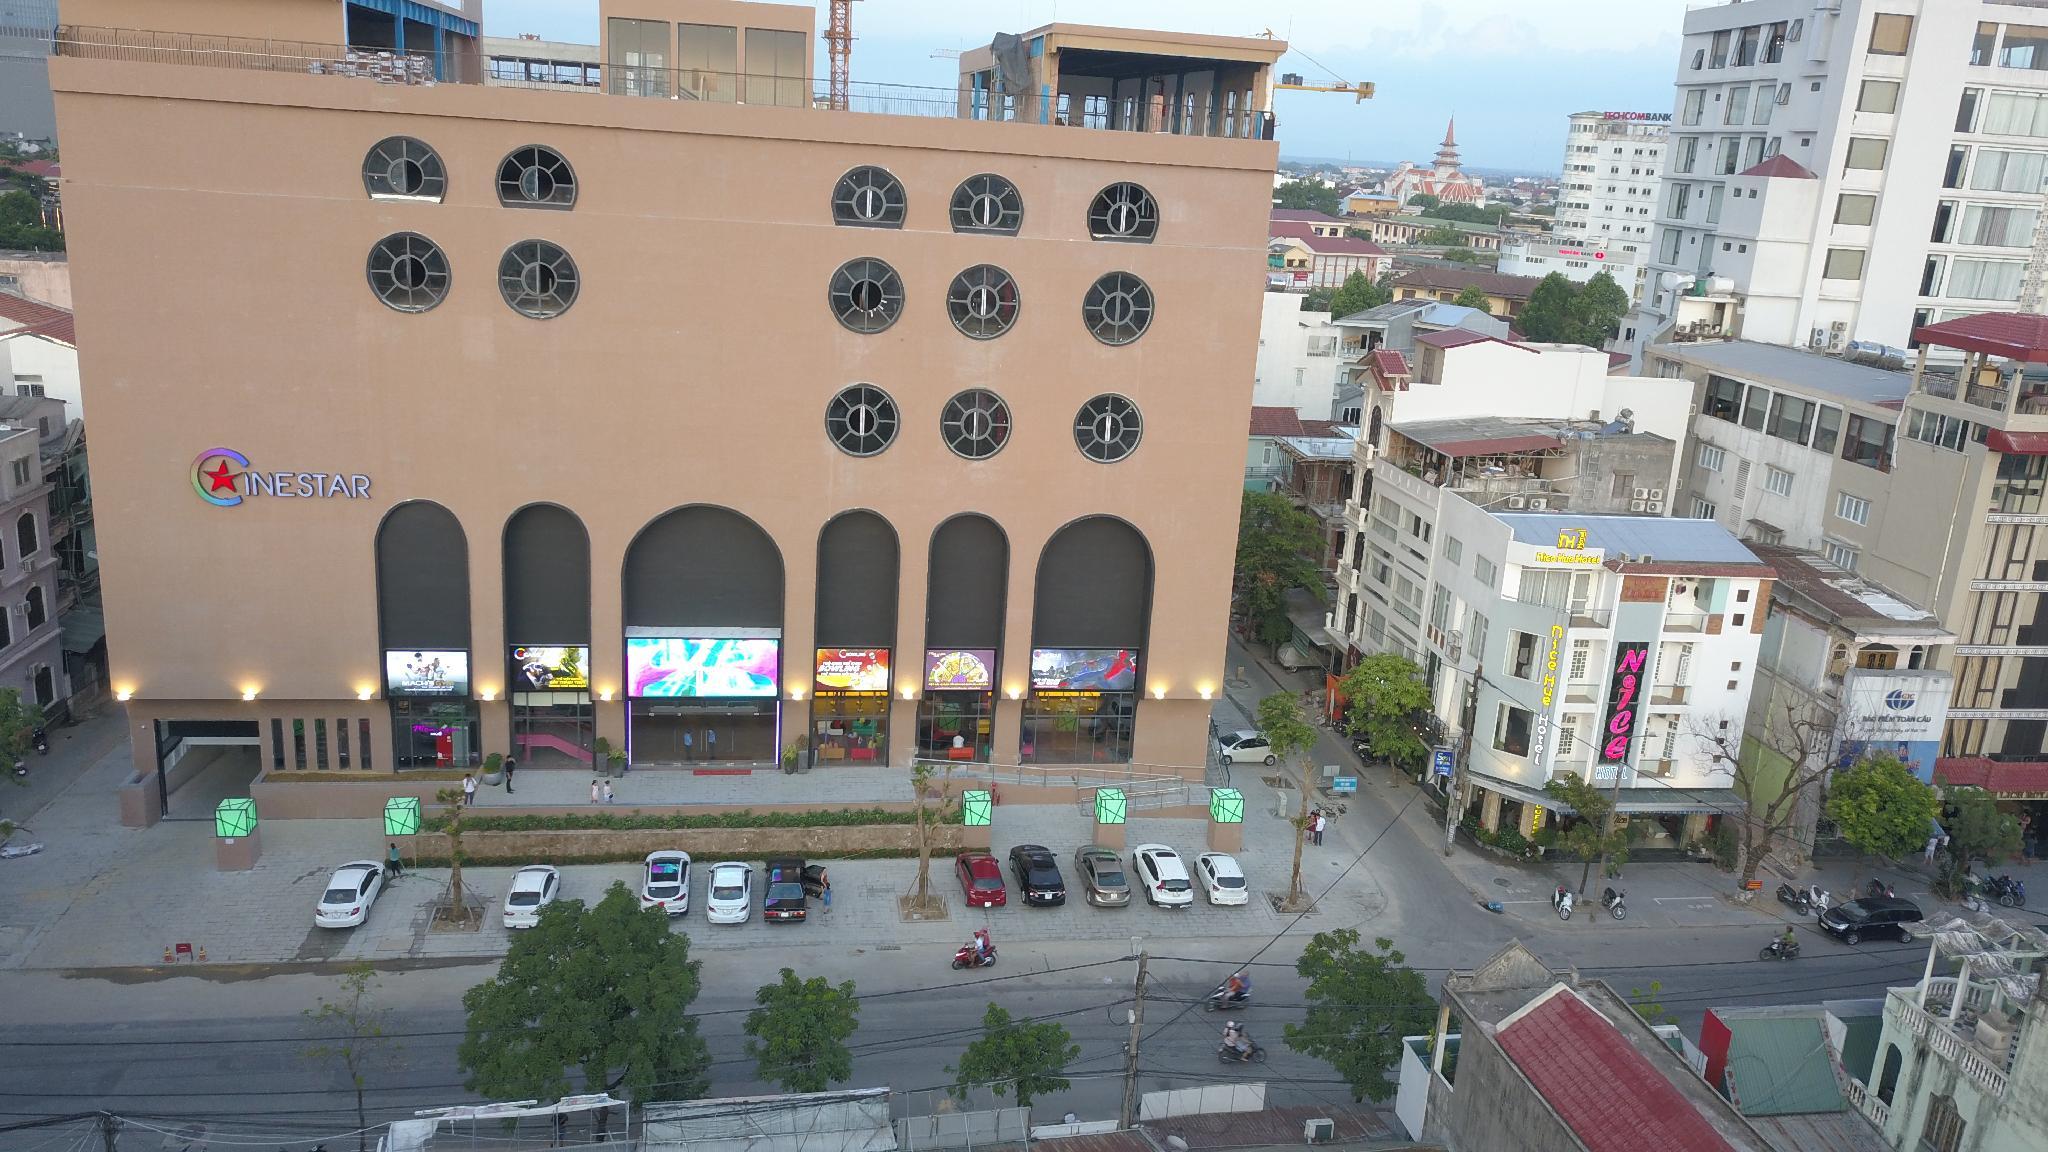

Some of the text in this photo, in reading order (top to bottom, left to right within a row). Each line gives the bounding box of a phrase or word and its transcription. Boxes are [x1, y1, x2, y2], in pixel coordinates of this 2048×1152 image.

[1603, 111, 1673, 122] TECHCOMBANK
[190, 447, 371, 507] CINESTAR
[1604, 648, 1649, 760] Nice
[1595, 766, 1628, 780] HOTL
